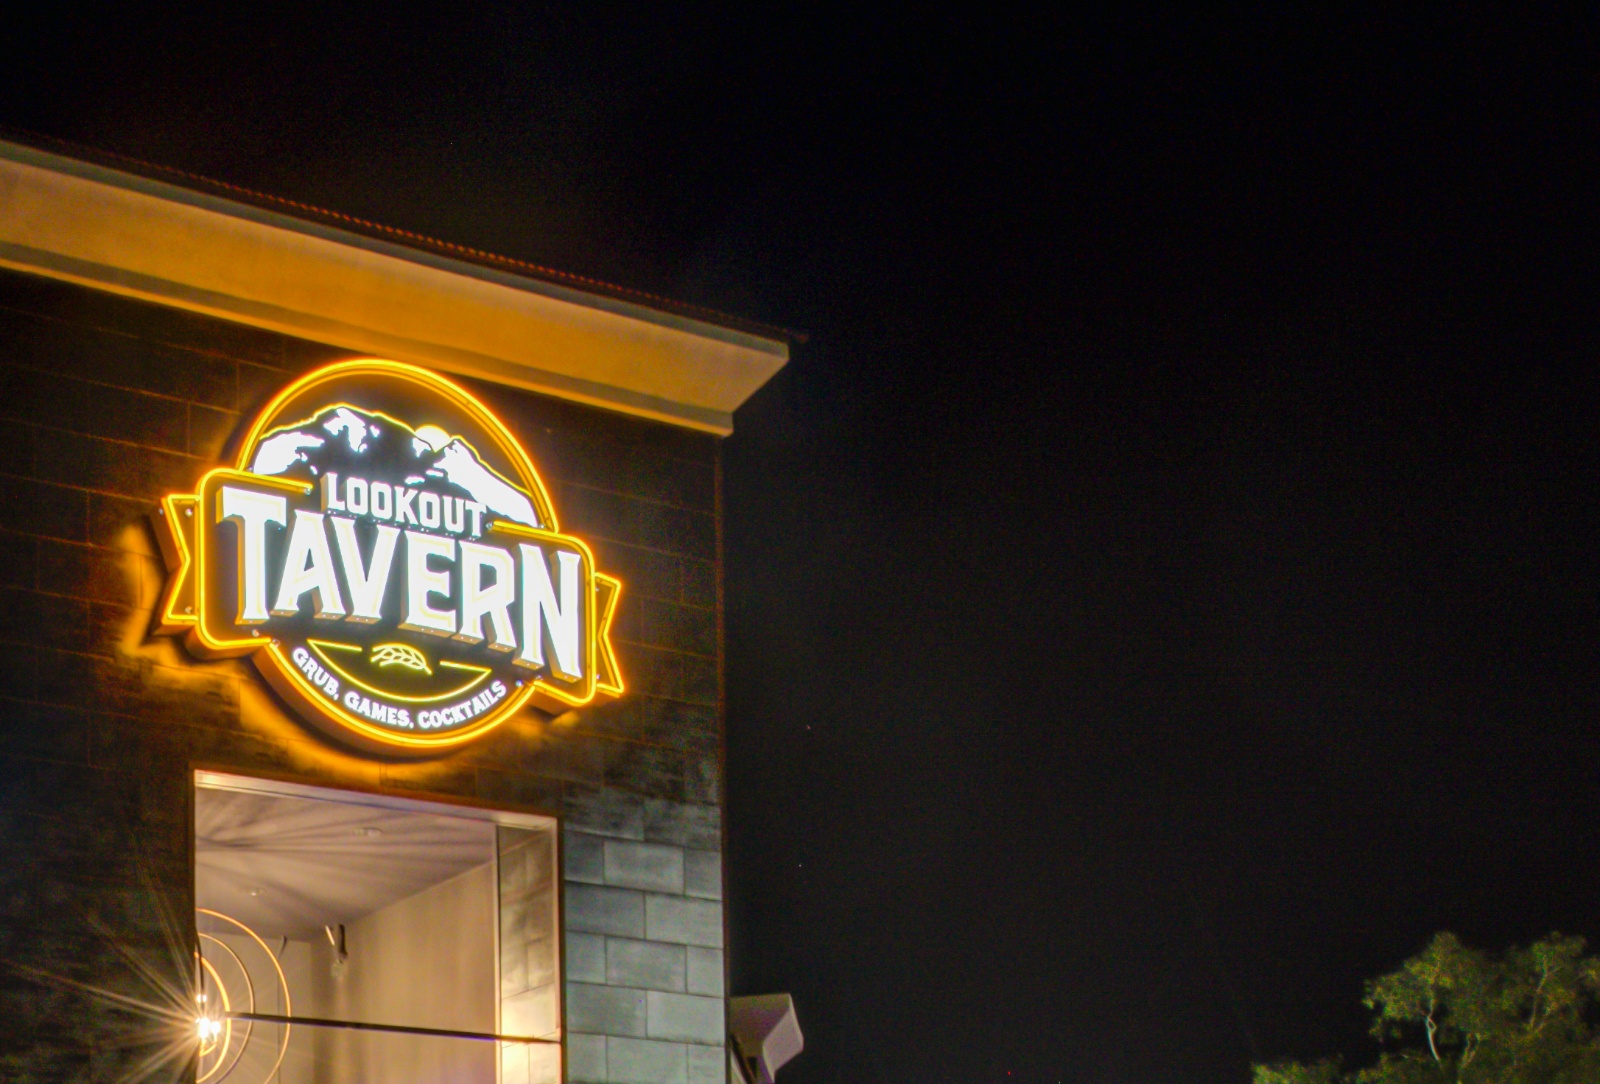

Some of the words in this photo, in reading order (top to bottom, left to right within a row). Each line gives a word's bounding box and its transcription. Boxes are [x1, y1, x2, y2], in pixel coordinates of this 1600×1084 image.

[321, 472, 487, 540] LOOKOUT
[216, 486, 582, 684] TAVERN
[292, 646, 339, 700] GRUB,
[344, 689, 415, 730] GAMES,
[418, 680, 507, 730] COCKTAILS
